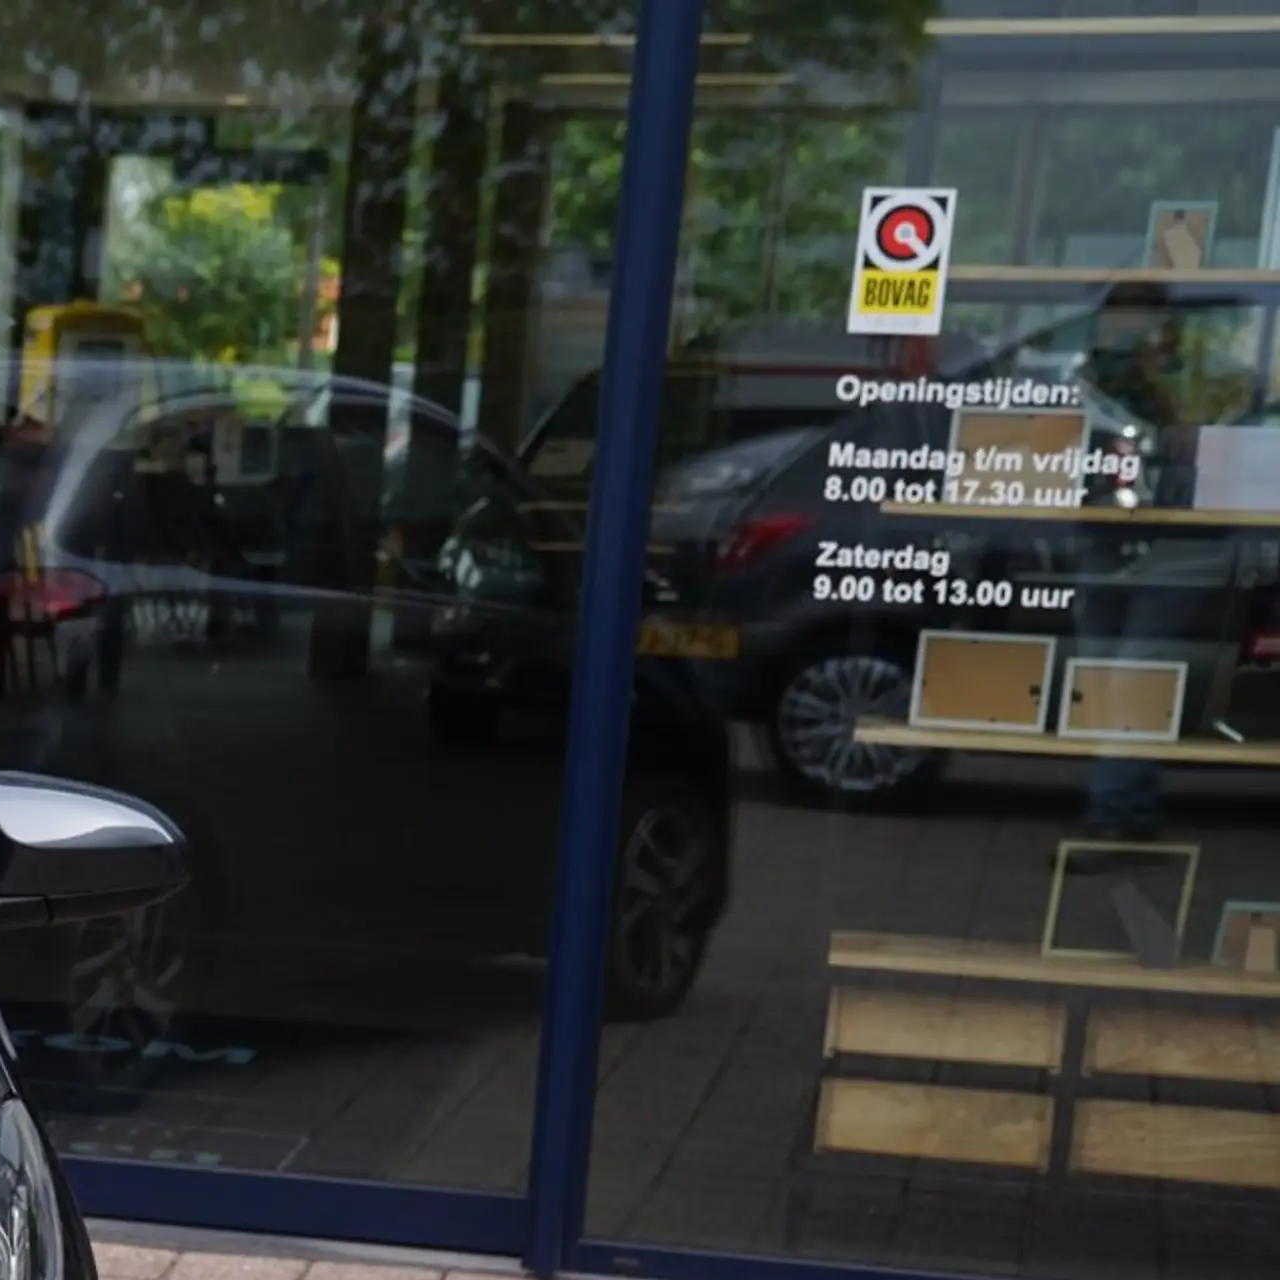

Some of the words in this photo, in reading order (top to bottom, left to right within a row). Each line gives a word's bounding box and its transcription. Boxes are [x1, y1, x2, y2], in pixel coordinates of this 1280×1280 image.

[864, 277, 931, 309] BOVAG
[836, 374, 1080, 409] Openingstijden:
[828, 442, 965, 476] Maandag
[975, 447, 1022, 472] t/m
[1033, 449, 1140, 481] vrijdag
[824, 476, 886, 502] 8.00
[894, 479, 936, 504] tot
[945, 480, 1023, 506] 17.30
[1034, 487, 1088, 507] uur
[815, 541, 950, 577] Zaterdag
[813, 574, 875, 601] 9.00
[882, 578, 925, 603] tot
[933, 579, 1012, 607] 13.00
[1021, 587, 1075, 609] uur
